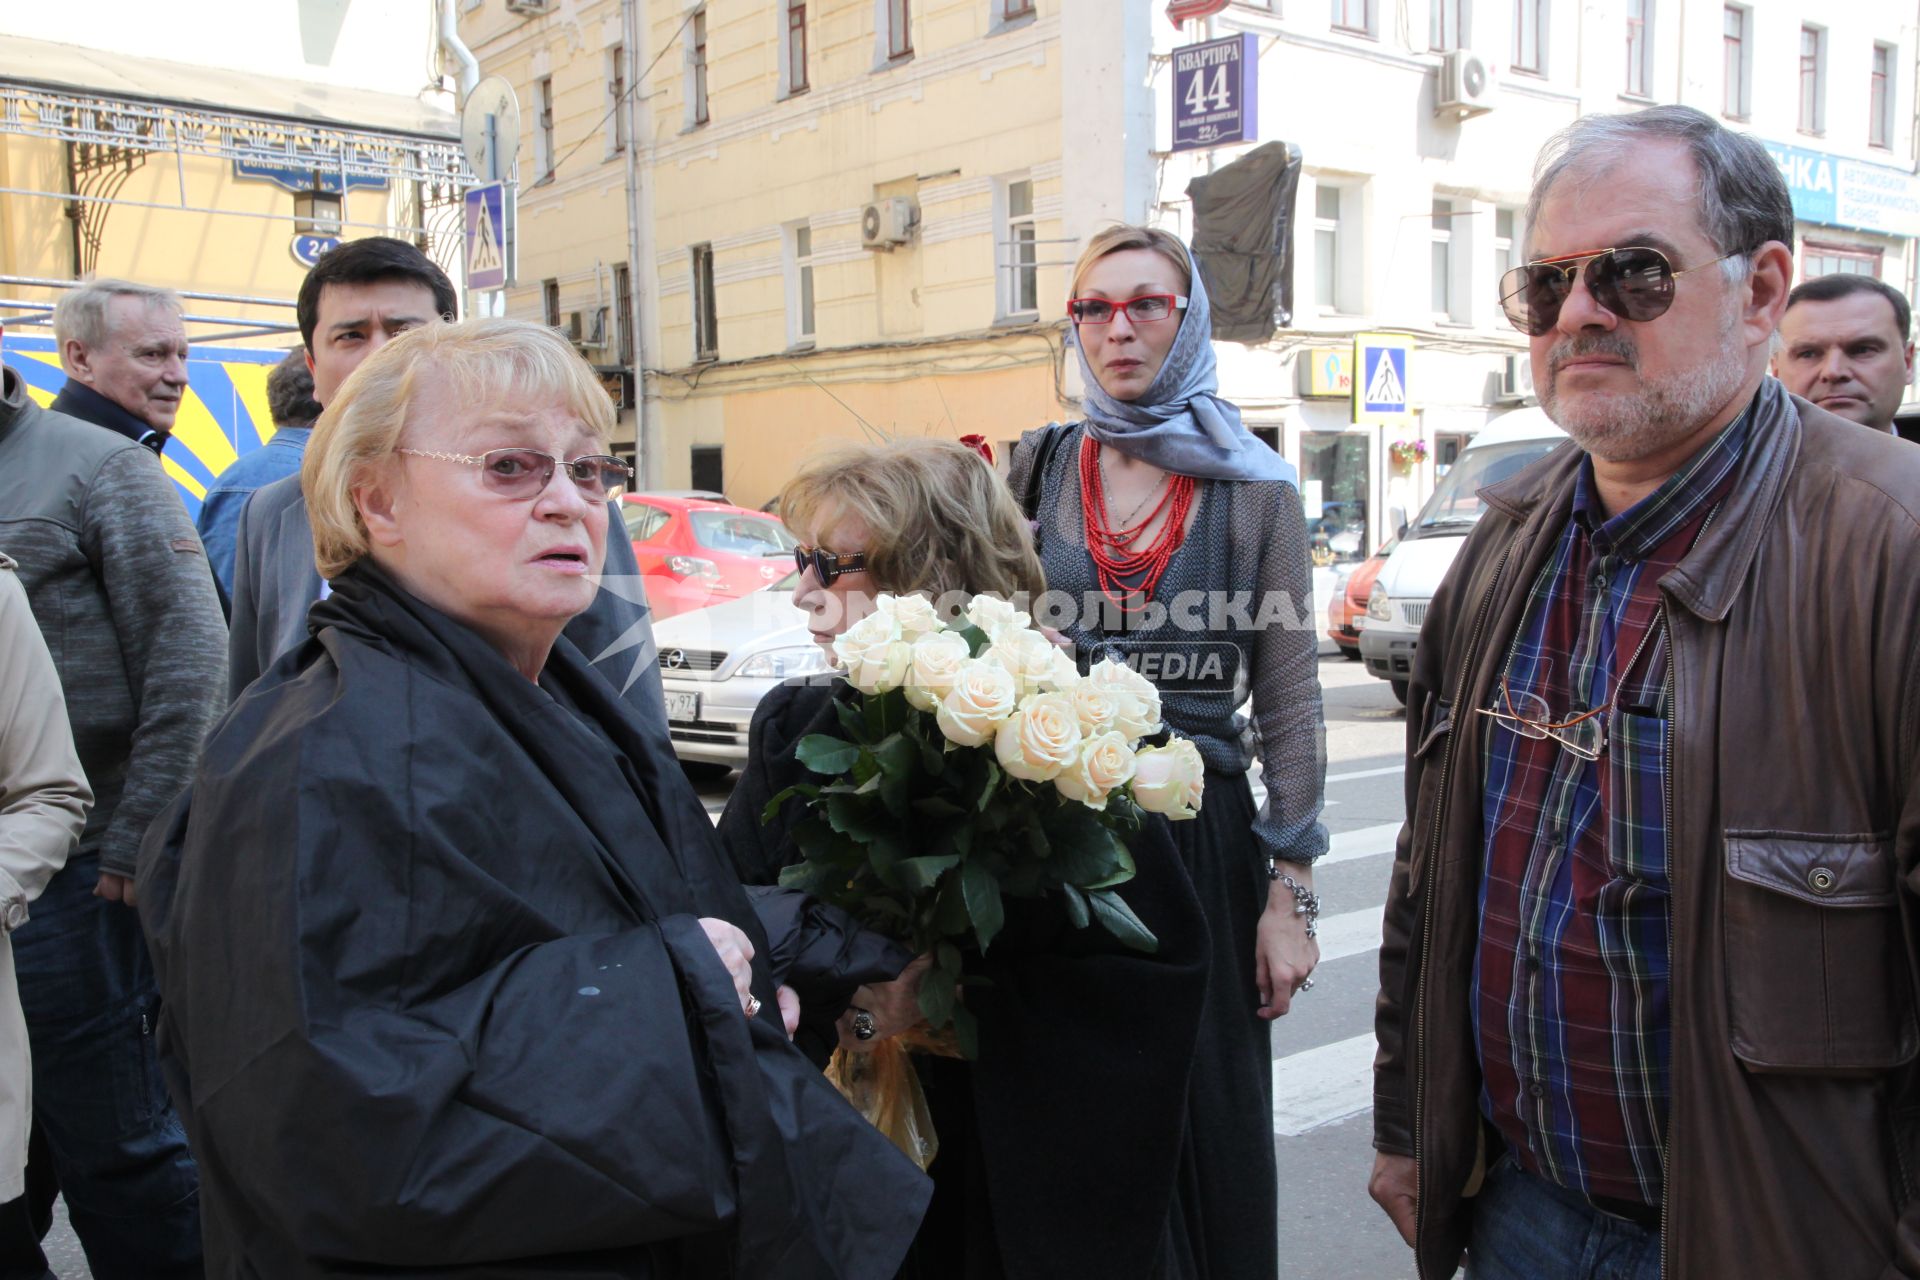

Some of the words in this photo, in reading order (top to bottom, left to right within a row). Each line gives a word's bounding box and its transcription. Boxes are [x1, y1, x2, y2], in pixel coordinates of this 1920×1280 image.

[1178, 43, 1239, 72] КВАРТИРА
[1184, 63, 1231, 115] 44
[1769, 150, 1833, 193] НКА
[308, 240, 329, 257] 24
